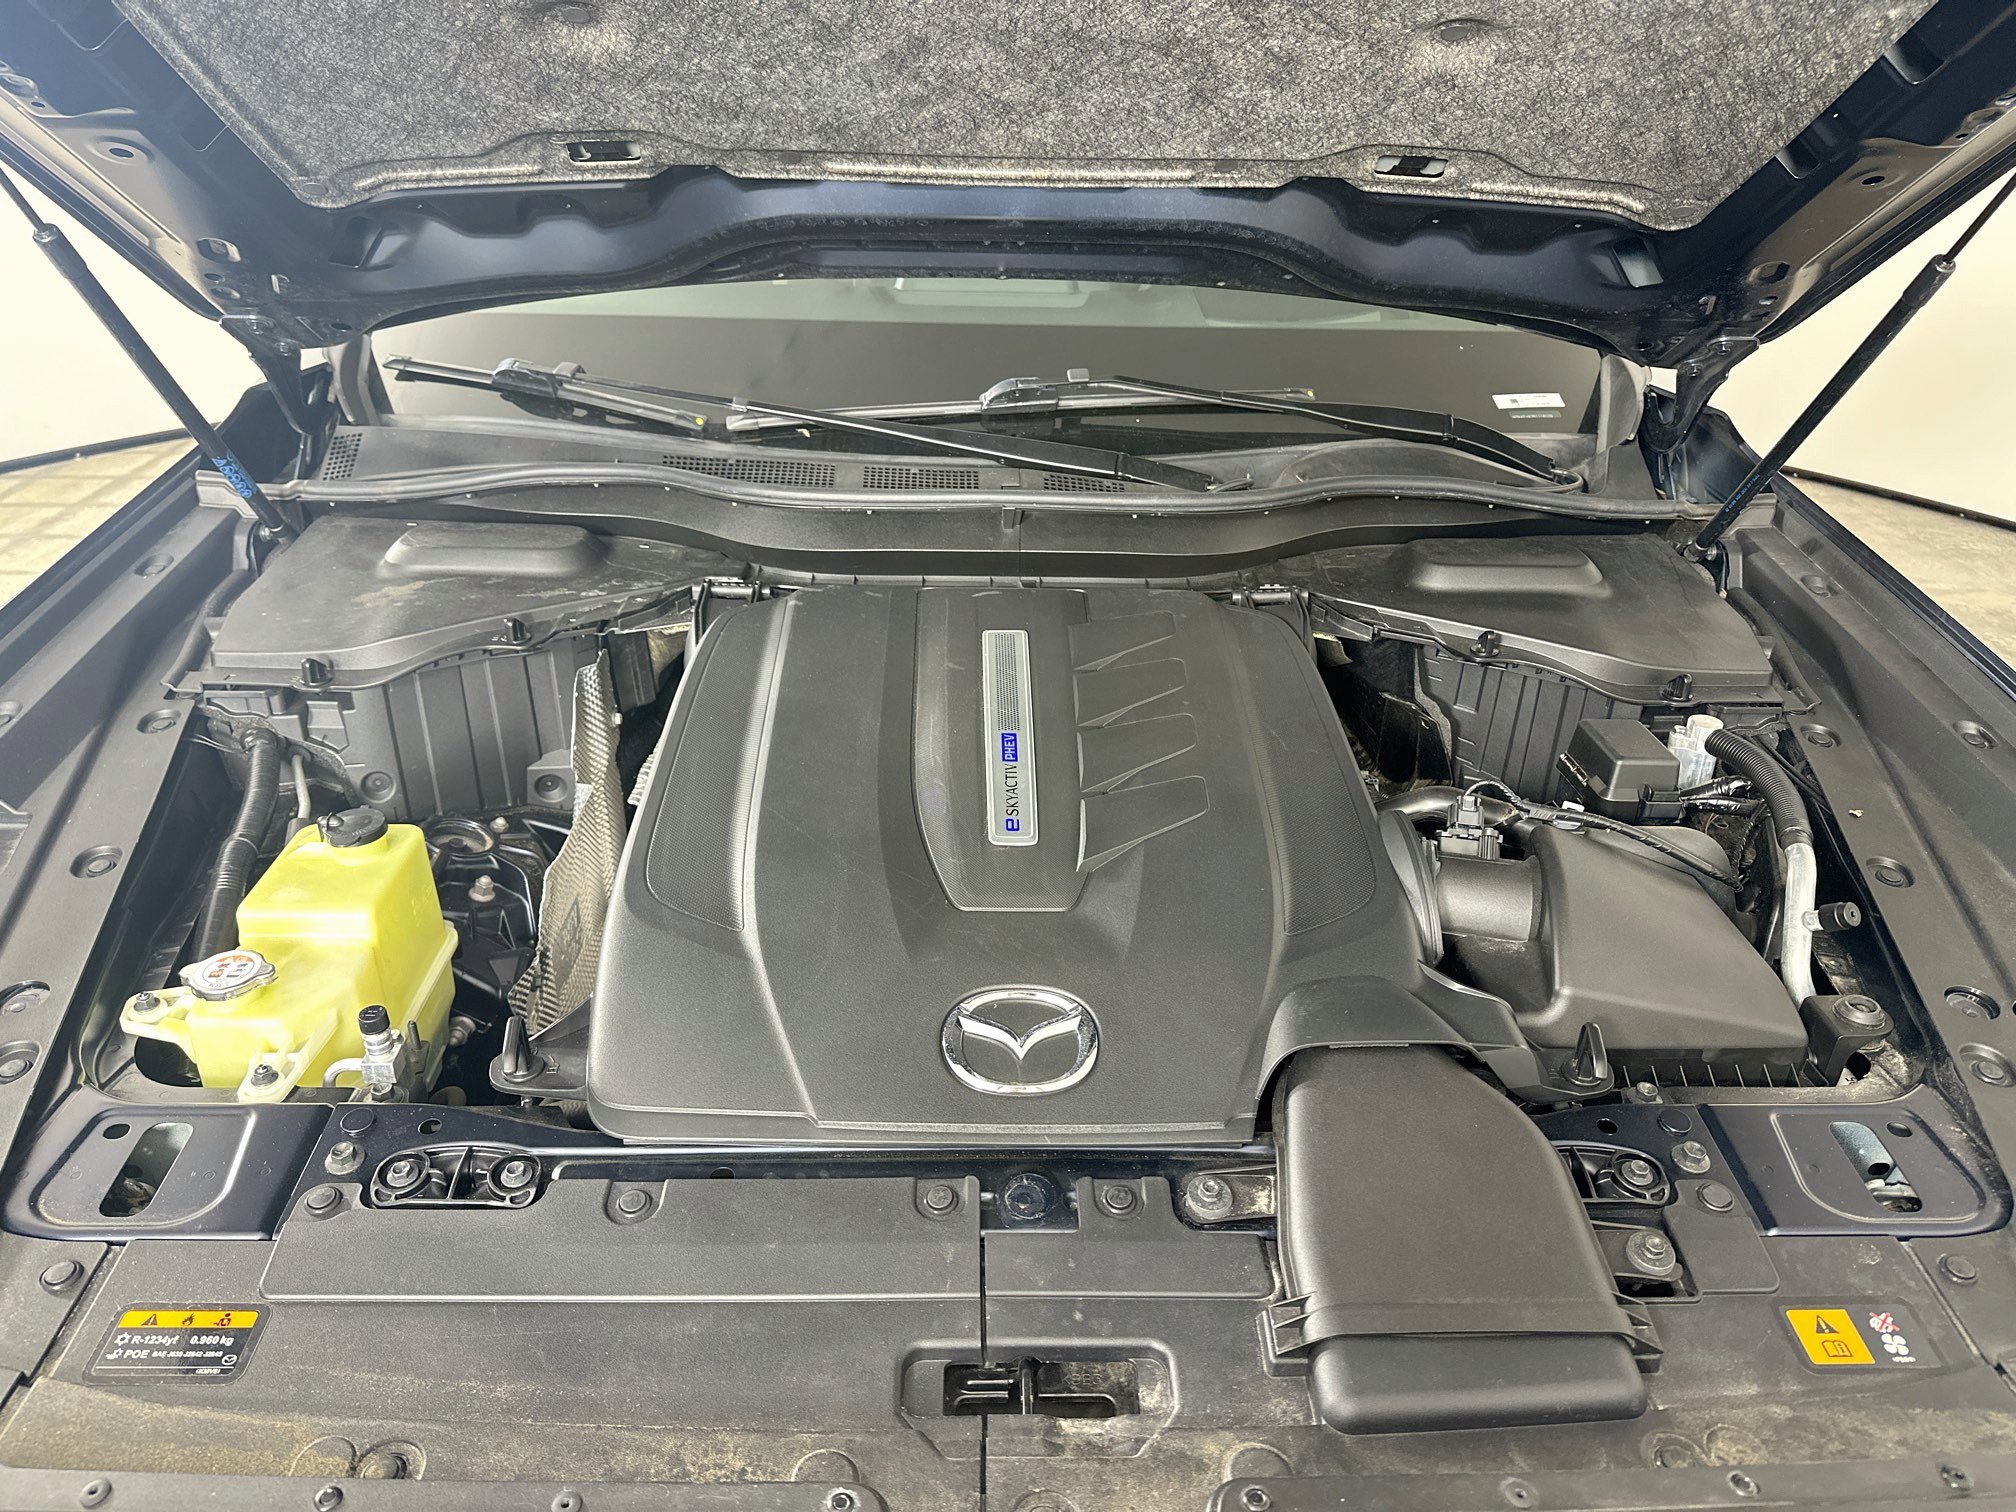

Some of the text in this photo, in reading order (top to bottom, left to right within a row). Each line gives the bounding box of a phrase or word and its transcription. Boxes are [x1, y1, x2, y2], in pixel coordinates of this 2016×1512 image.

[1002, 733, 1017, 761] PHEV
[1004, 763, 1019, 817] SKYACTIV
[131, 1334, 235, 1347] R-1234yf 0.960 kg
[124, 1349, 150, 1359] POE
